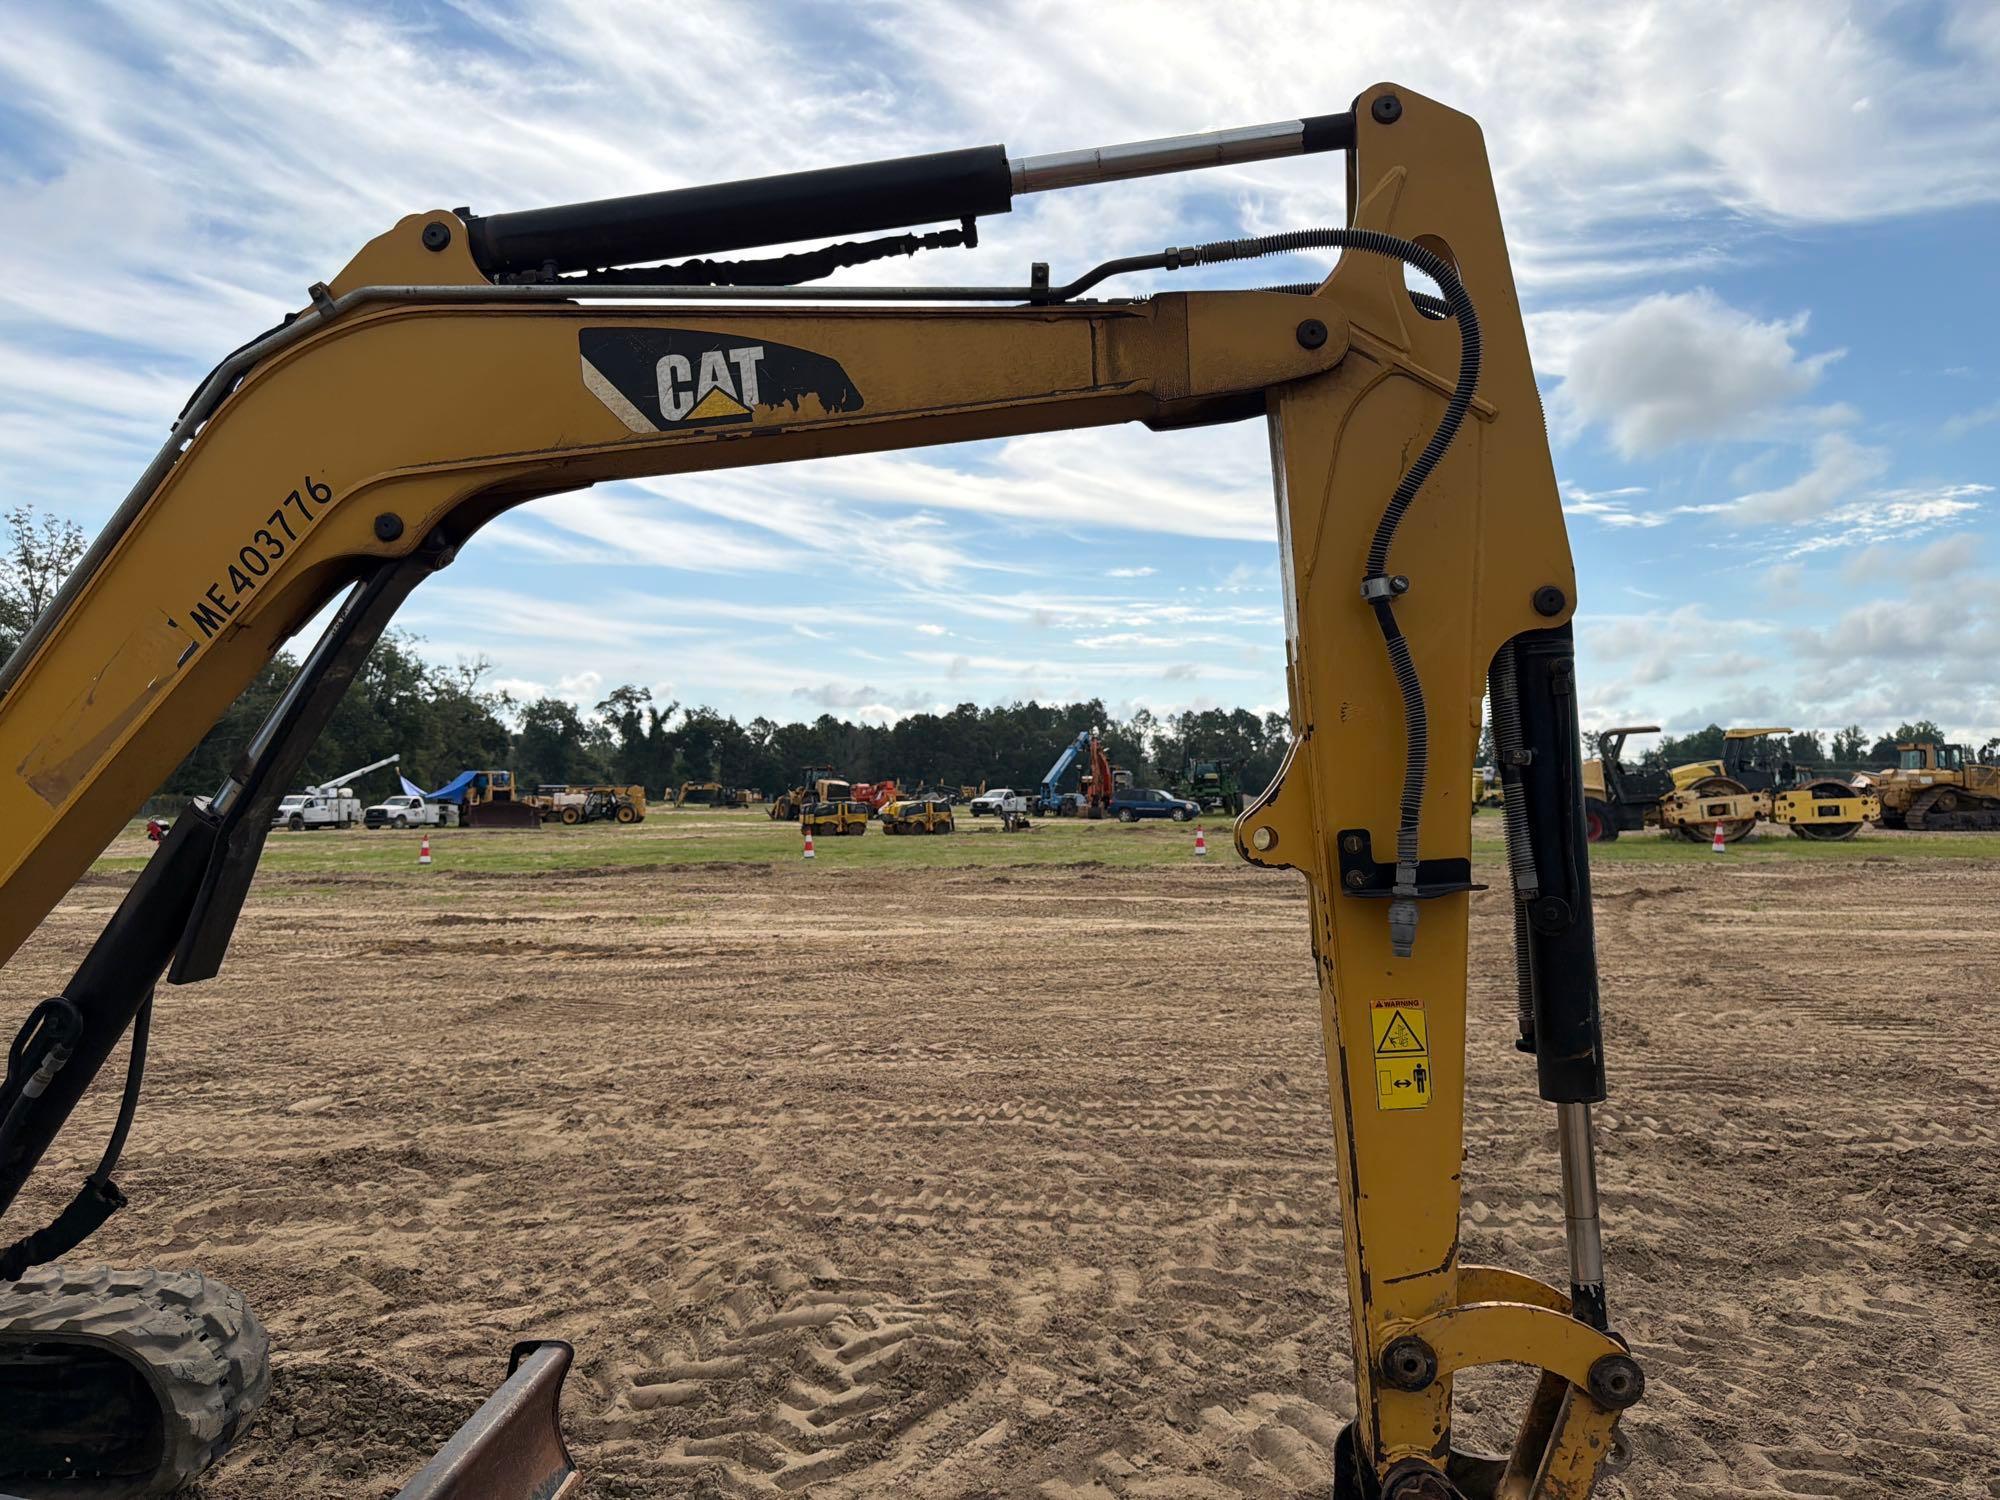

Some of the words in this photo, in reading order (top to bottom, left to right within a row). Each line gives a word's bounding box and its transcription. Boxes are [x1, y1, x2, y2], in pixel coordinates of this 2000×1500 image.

[656, 345, 765, 422] CAT
[189, 475, 333, 639] ME403776
[1383, 999, 1419, 1008] WARNING
